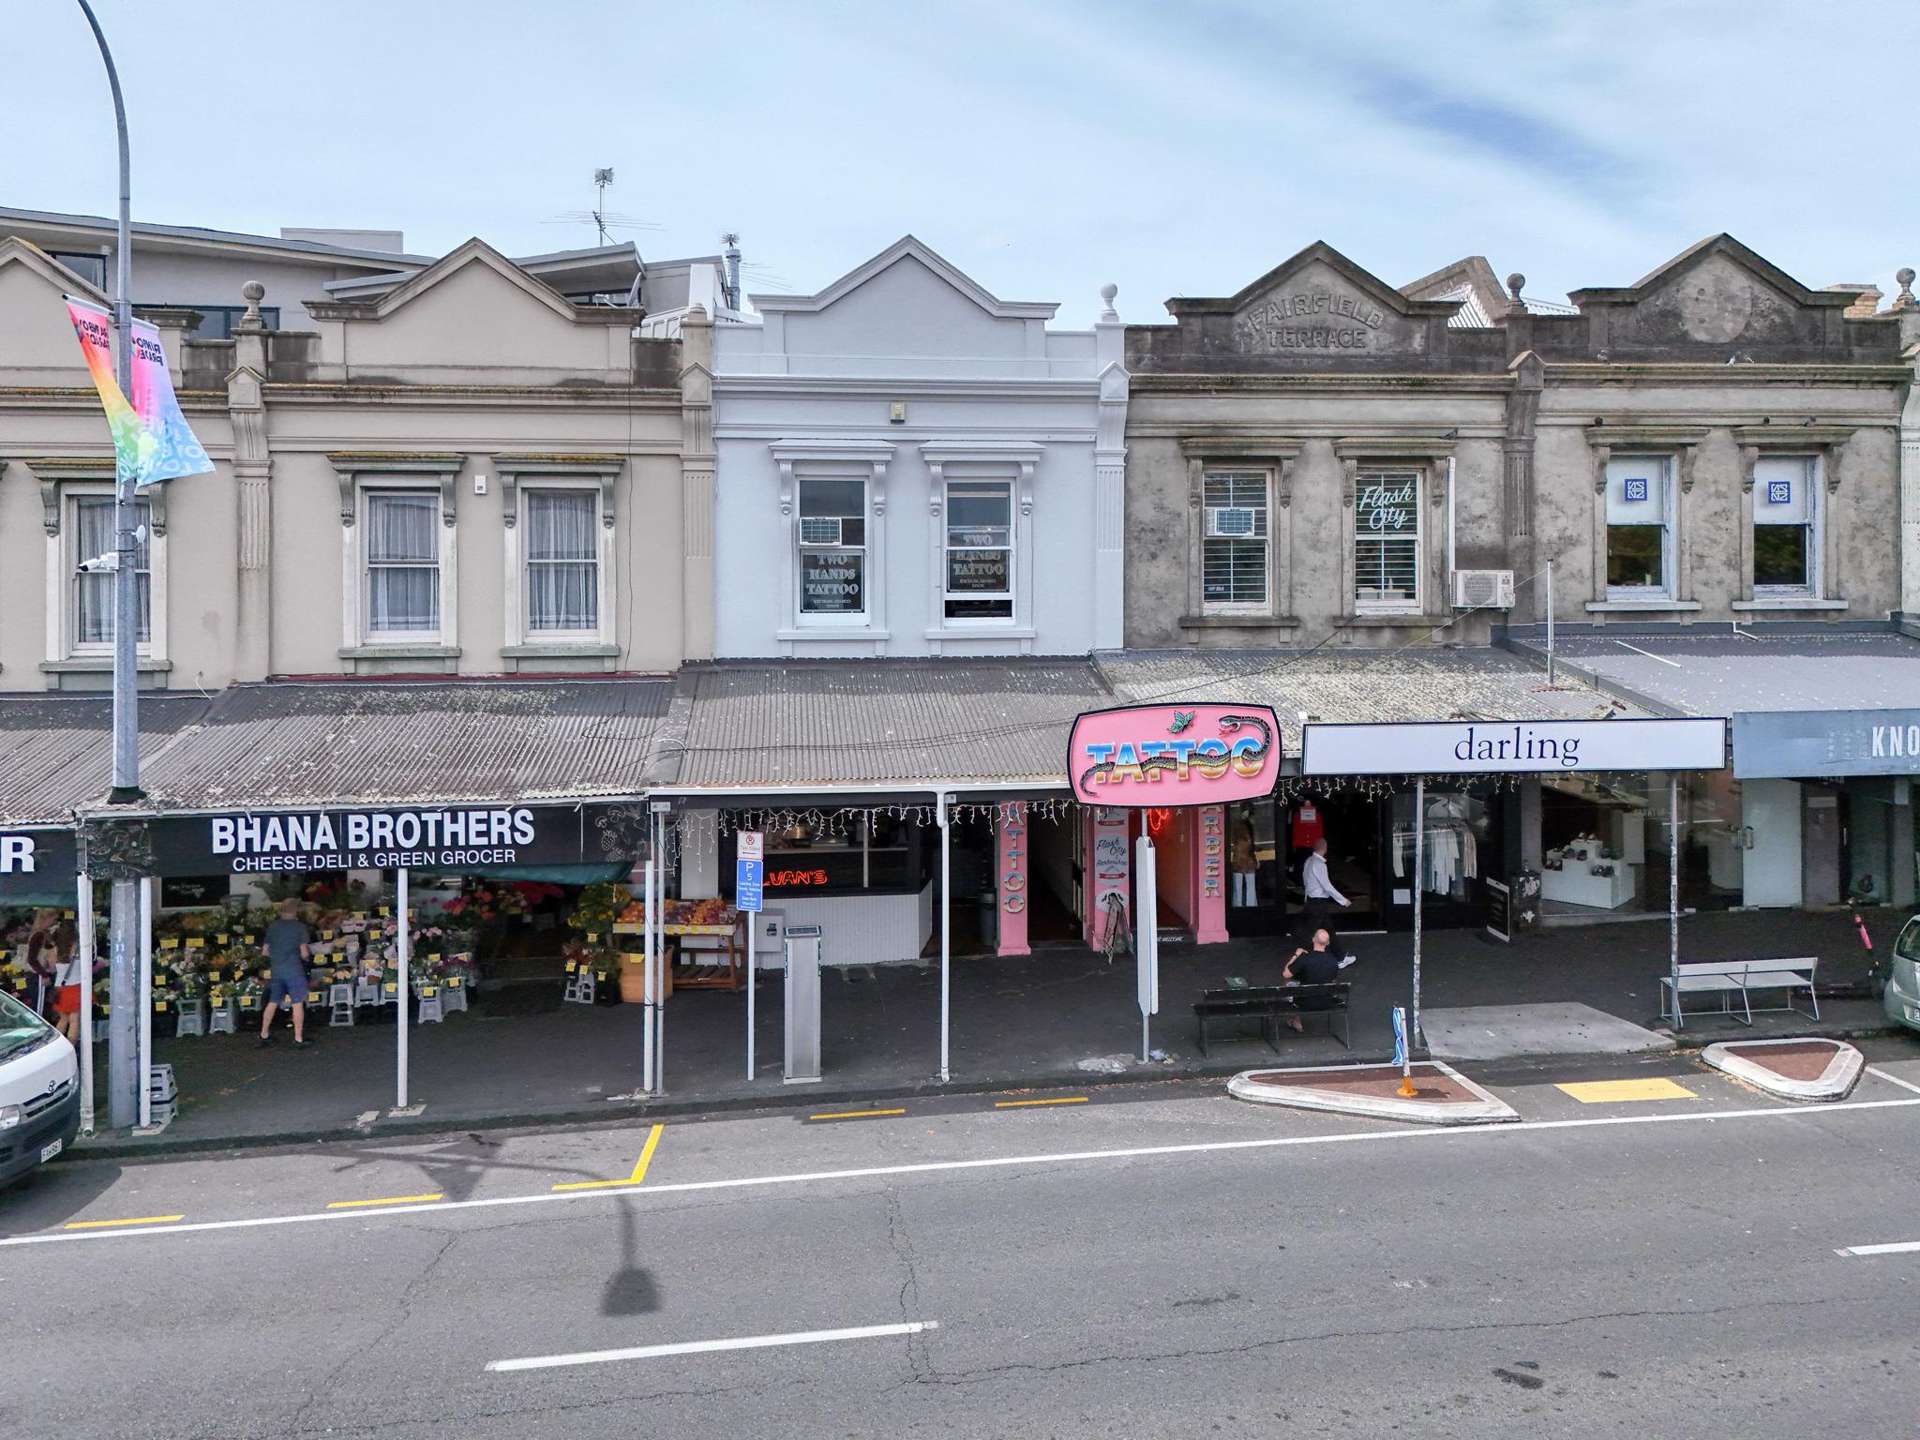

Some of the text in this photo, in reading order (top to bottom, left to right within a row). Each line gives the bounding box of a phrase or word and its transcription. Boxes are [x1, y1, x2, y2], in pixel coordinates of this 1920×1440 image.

[1247, 294, 1384, 333] FAIRFIELD
[1266, 327, 1367, 348] TERRACE
[1359, 480, 1413, 512] Flash
[1370, 506, 1408, 529] City
[962, 534, 993, 545] TWO
[816, 555, 848, 565] TWO
[956, 550, 1001, 561] HANDS
[809, 568, 857, 580] HANDS
[953, 563, 1005, 576] TATTOO
[806, 583, 860, 596] TATTOO
[1455, 726, 1580, 767] darling
[1872, 726, 1920, 757] KNO
[1086, 736, 1266, 784] TATTOO
[212, 809, 535, 854] BHANA BROTHERS
[357, 853, 369, 868] &
[374, 851, 436, 868] GREEN
[441, 849, 516, 865] GROCER
[745, 861, 755, 872] P
[1003, 800, 1025, 914] ATTOO
[763, 869, 829, 887] VAN'S
